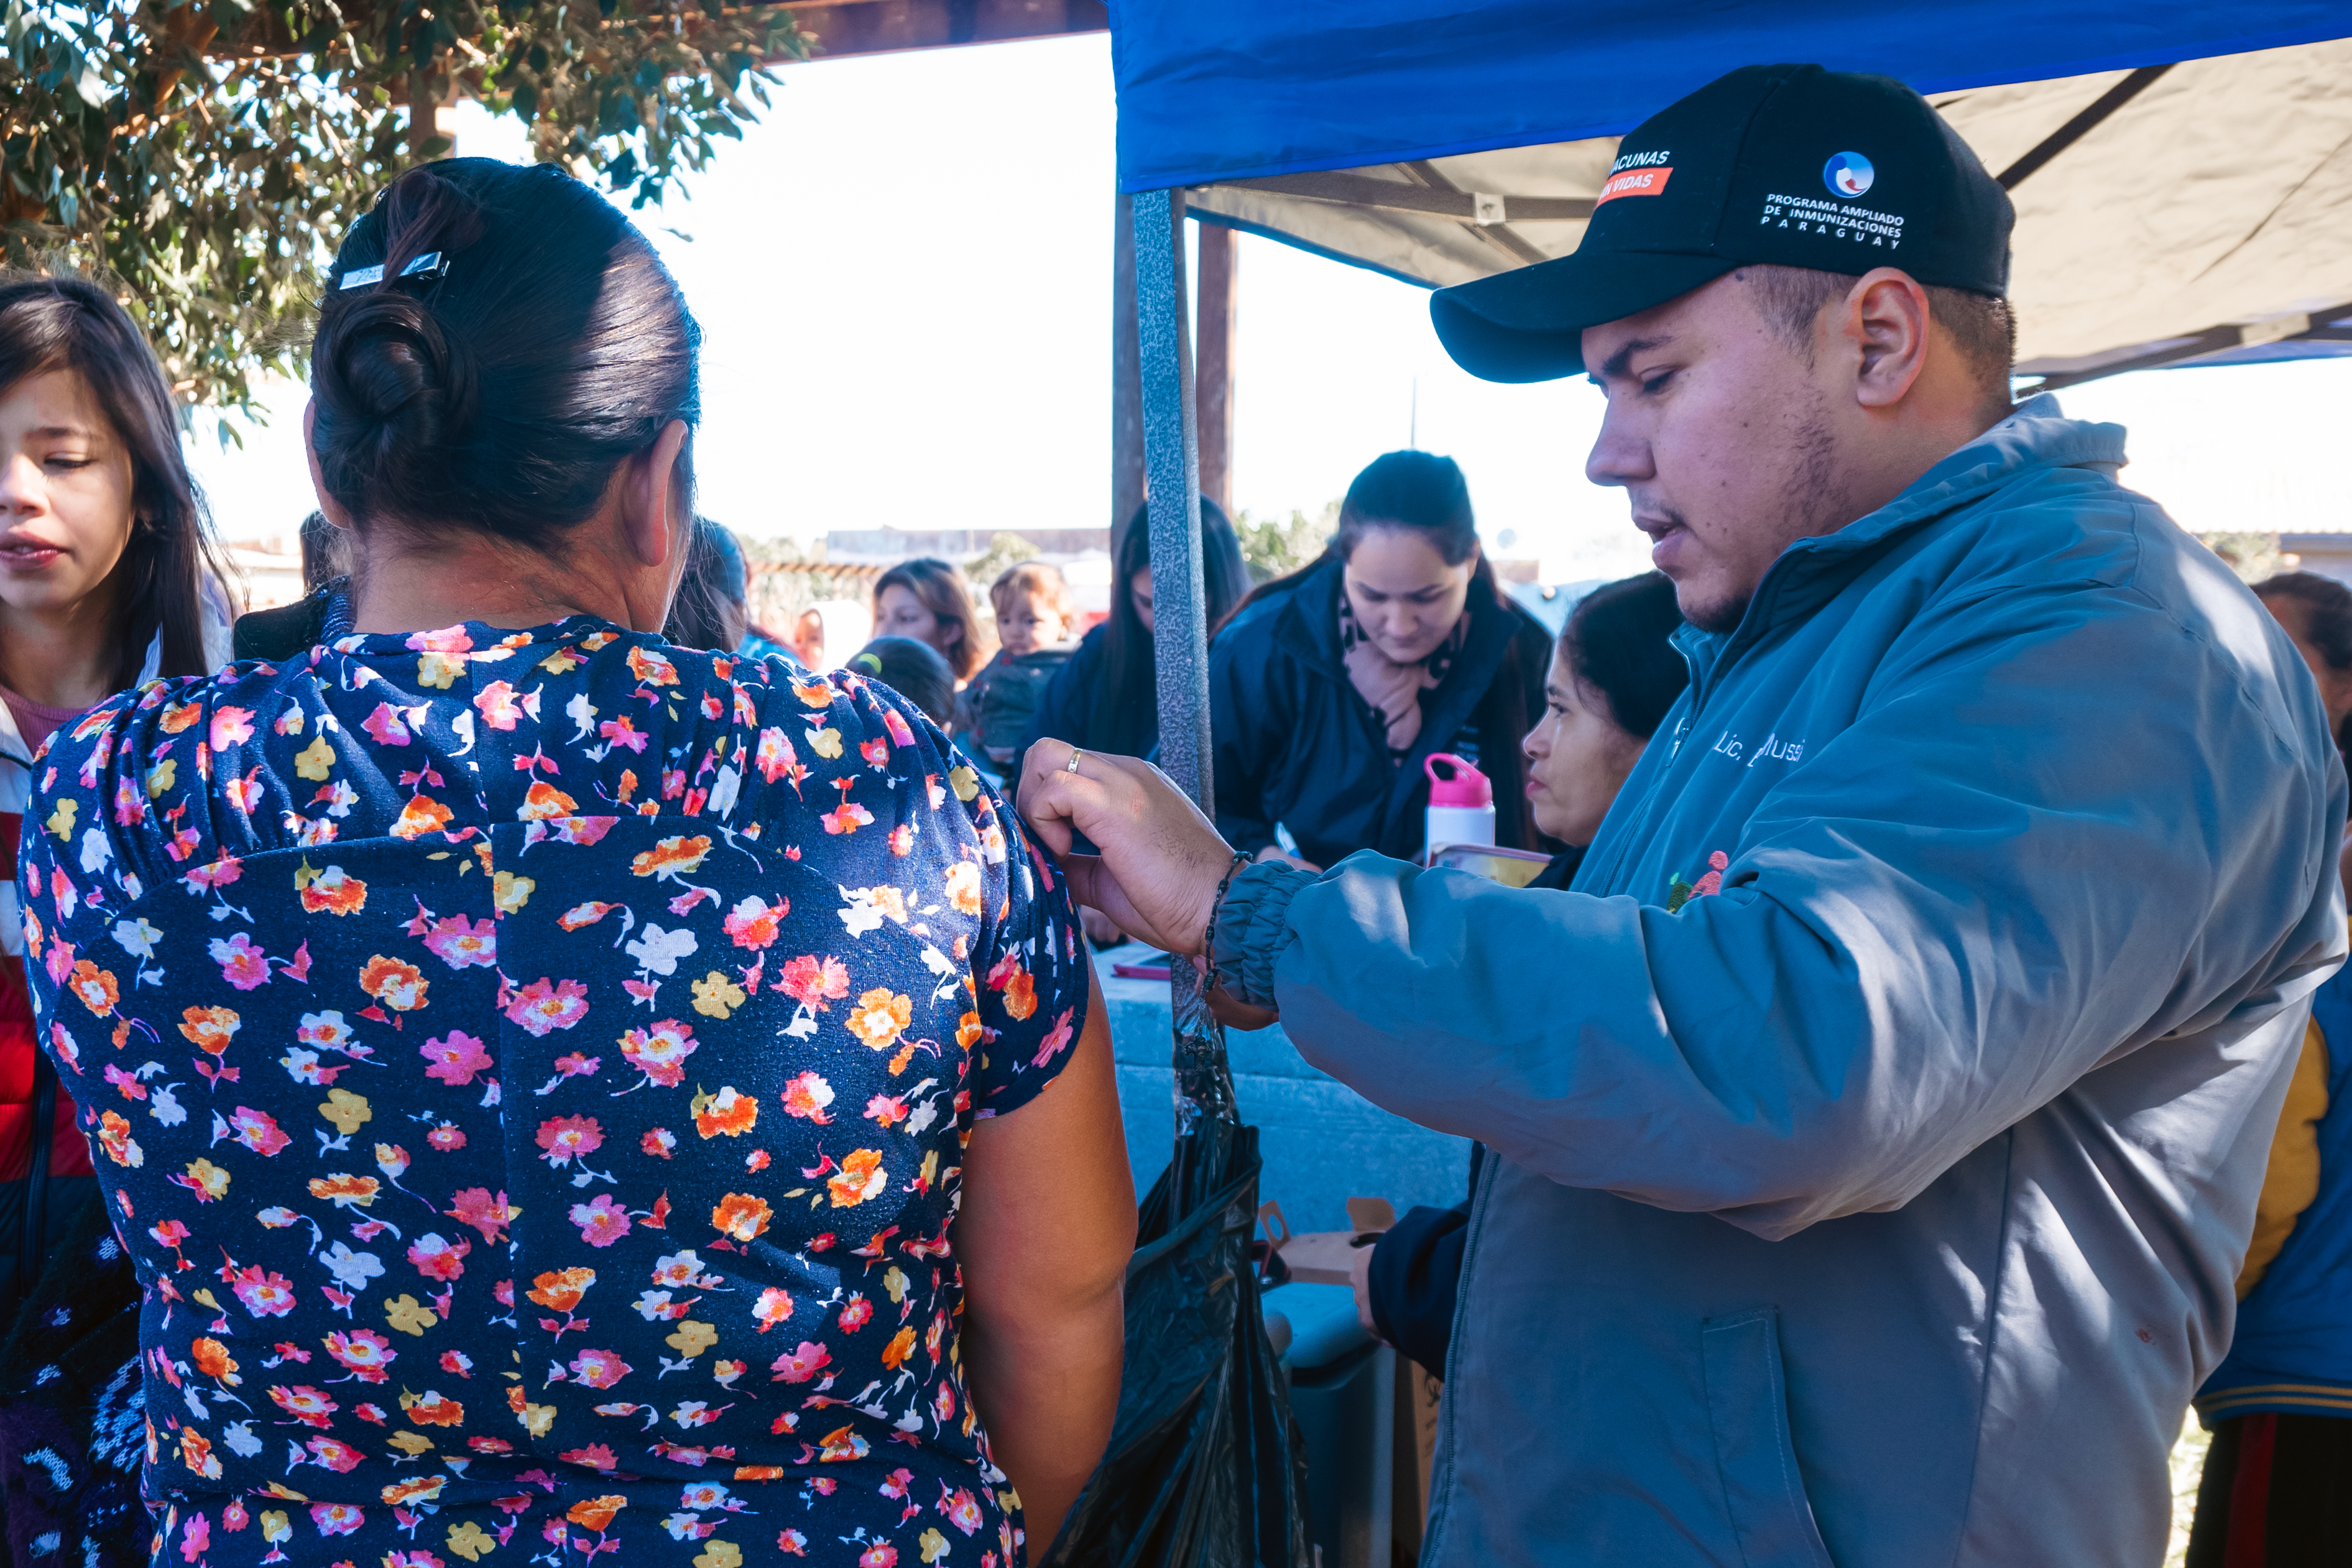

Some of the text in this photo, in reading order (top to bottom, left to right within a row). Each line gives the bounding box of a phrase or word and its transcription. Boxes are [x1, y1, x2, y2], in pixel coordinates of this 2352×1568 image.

[1613, 173, 1654, 193] VIDAS
[1763, 205, 1902, 238] DE INMUNIZACIONES
[1766, 193, 1904, 226] PROGRAMA AMPLIADO
[1760, 216, 1900, 250] PARAGUAY
[1713, 730, 1743, 761] Lic.
